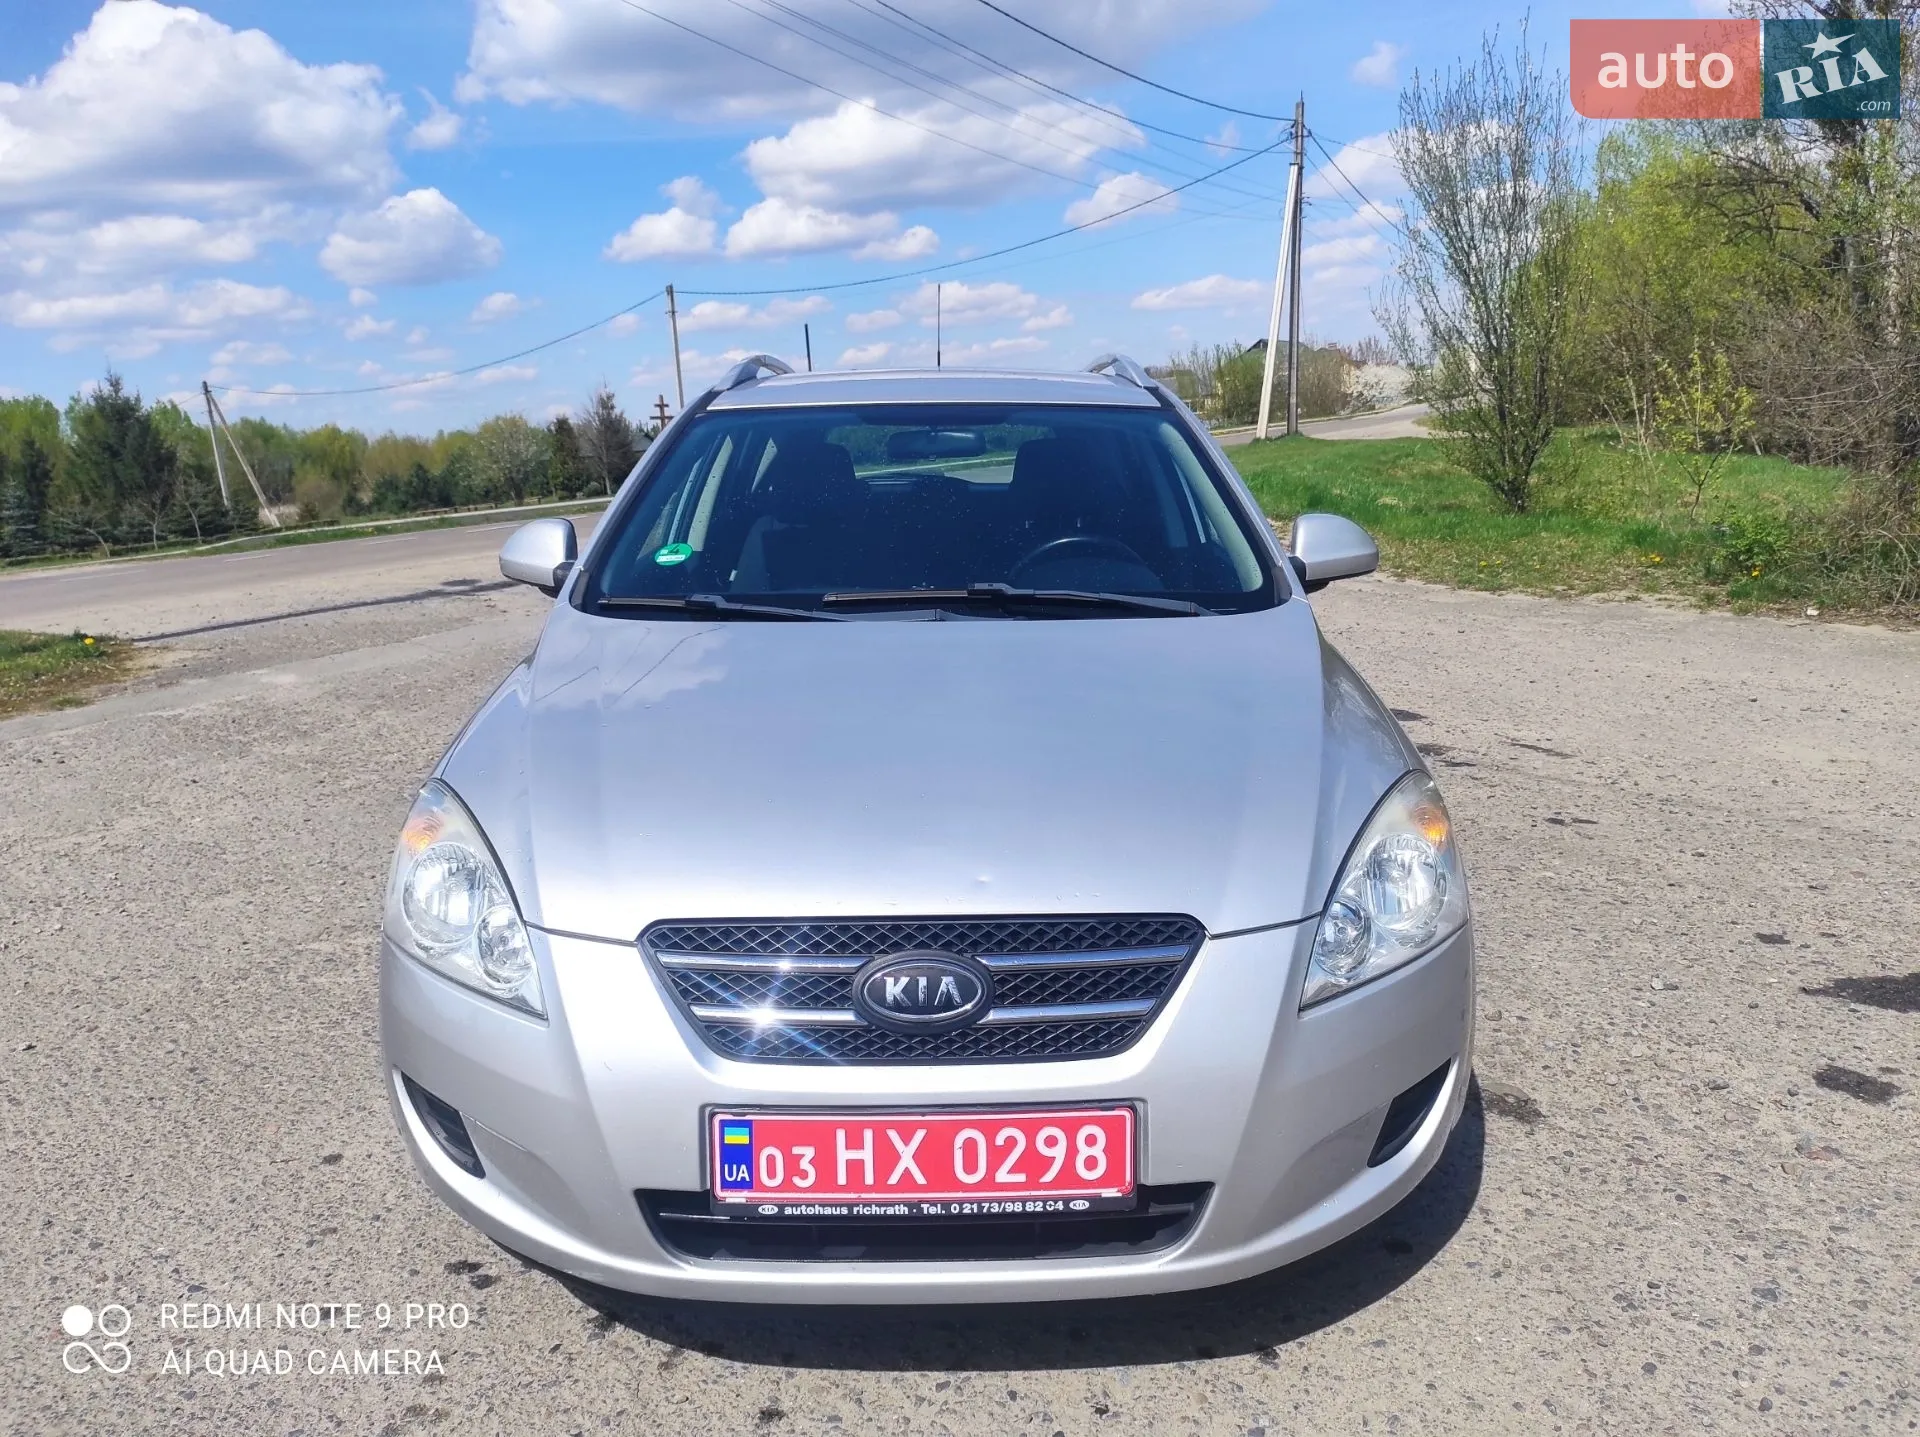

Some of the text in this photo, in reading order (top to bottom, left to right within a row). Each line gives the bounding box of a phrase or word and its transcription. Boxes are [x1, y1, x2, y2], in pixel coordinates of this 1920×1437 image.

[884, 976, 963, 1007] KIA
[759, 1124, 1107, 1188] 03 HX 0298
[724, 1164, 750, 1182] UA
[784, 1205, 848, 1215] autohaus
[853, 1204, 909, 1215] richrath
[921, 1203, 945, 1214] Tel.
[951, 1203, 960, 1214] 0
[962, 1203, 978, 1213] 21
[982, 1201, 1023, 1213] 73/98
[1025, 1201, 1043, 1212] 82
